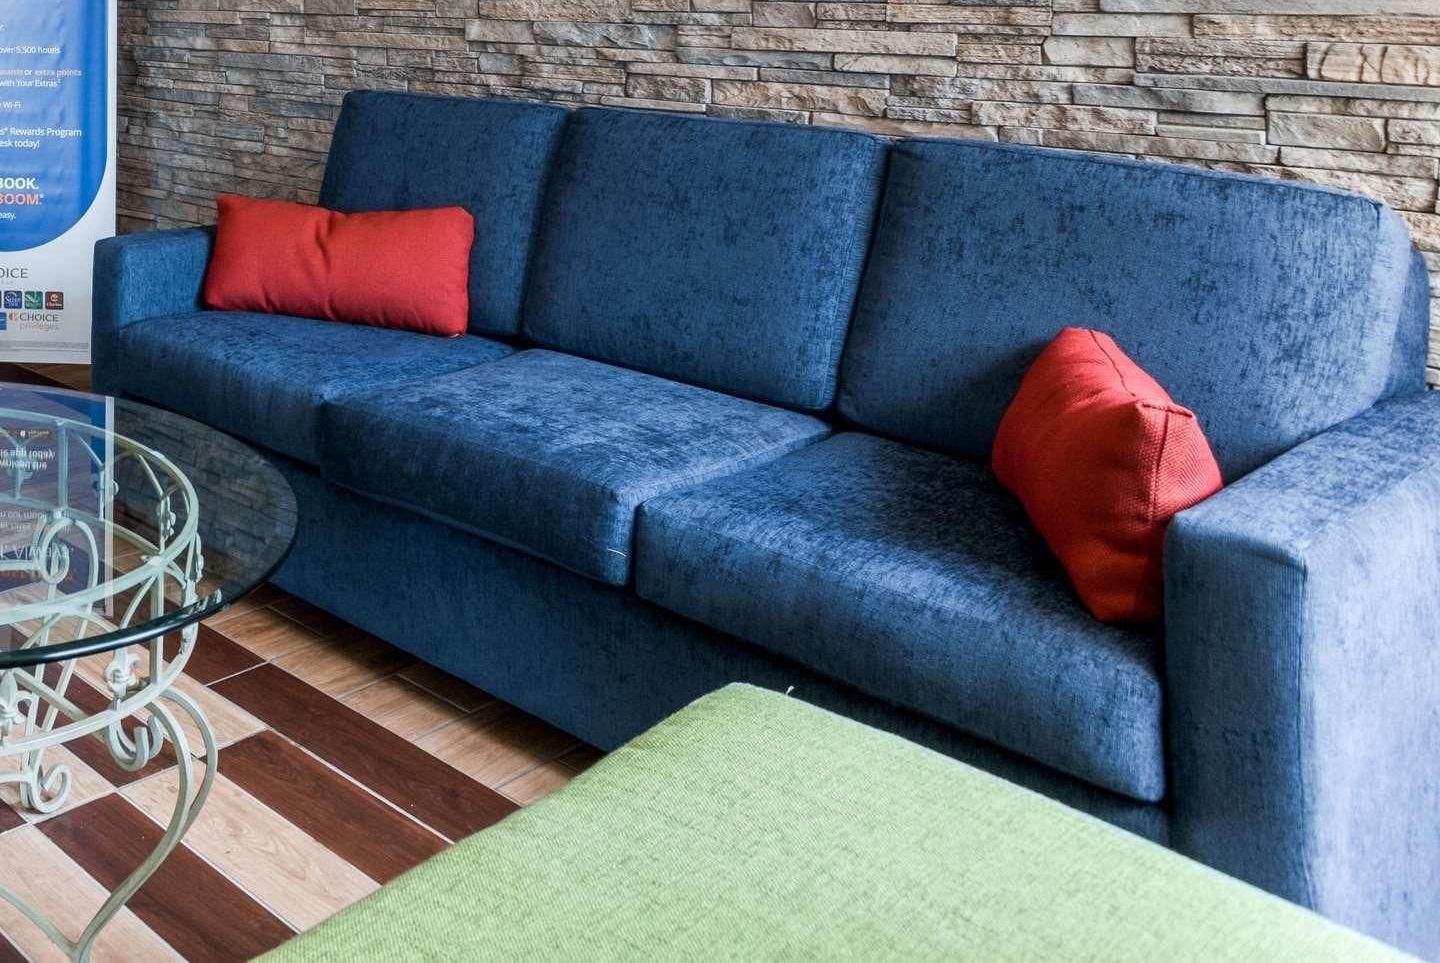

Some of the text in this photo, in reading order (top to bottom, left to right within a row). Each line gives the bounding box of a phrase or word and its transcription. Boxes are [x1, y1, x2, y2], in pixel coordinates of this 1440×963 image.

[57, 68, 82, 78] points
[0, 79, 15, 87] with
[16, 79, 33, 87] Your
[10, 127, 45, 136] Rewards
[46, 127, 82, 138] Program
[15, 139, 40, 149] today!
[19, 312, 60, 322] CHOICE
